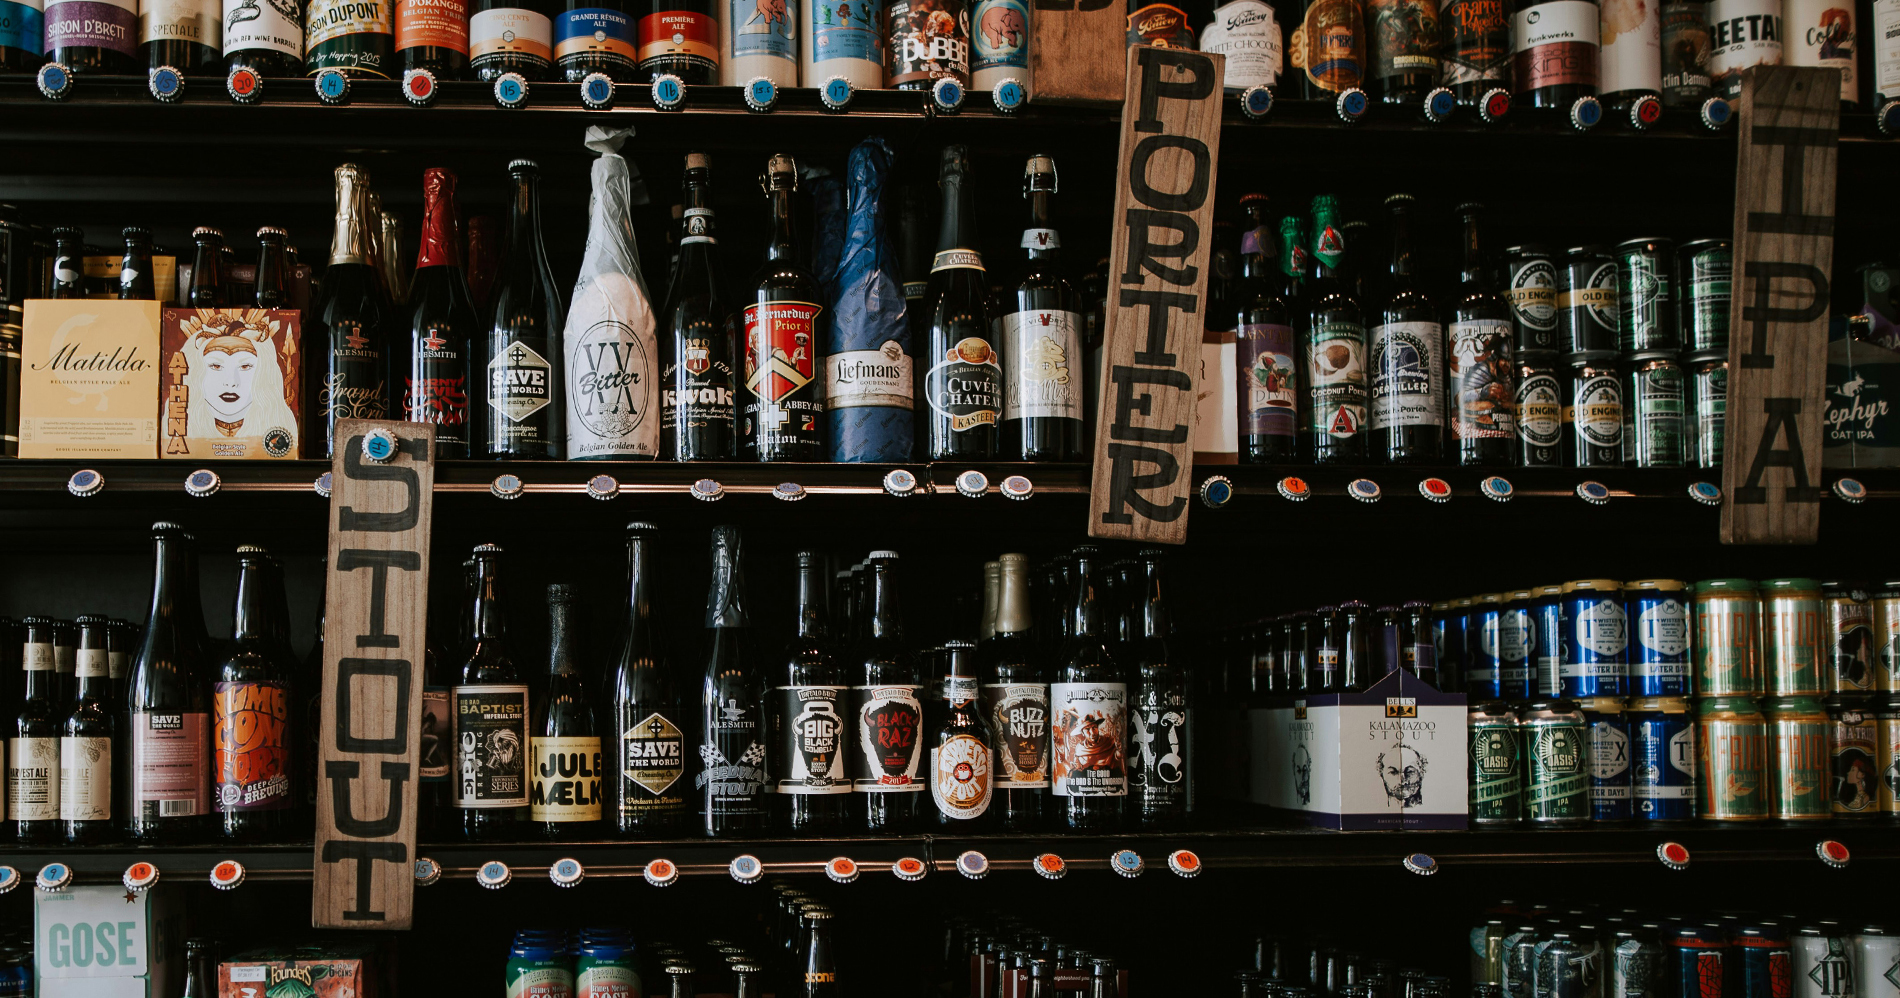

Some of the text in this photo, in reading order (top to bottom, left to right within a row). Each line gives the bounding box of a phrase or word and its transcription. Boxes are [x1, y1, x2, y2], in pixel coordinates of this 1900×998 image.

[328, 2, 380, 24] DUPONT
[403, 8, 440, 17] BELGIAN
[507, 14, 530, 22] CENTS
[570, 14, 599, 22] GRANDE
[662, 16, 696, 25] PREMIÈRE
[48, 20, 126, 40] SAISON D'BRETT
[152, 24, 200, 39] SPECIALE
[1527, 31, 1575, 44] funkwerks
[1730, 44, 1745, 52] CO.
[329, 51, 359, 67] Hopping
[504, 85, 516, 97] 15
[664, 82, 677, 97] 16
[833, 86, 846, 97] 17
[1003, 88, 1015, 102] 14
[1102, 47, 1216, 525] PORTER
[1582, 292, 1603, 302] OLD
[1733, 125, 1839, 505] IPA
[775, 319, 810, 331] Prior 8
[493, 370, 546, 391] SAVE
[835, 359, 901, 391] Liefmans
[579, 370, 642, 396] Bitter
[318, 373, 385, 411] Grand
[513, 387, 546, 396] WORLD
[1310, 386, 1345, 400] COCONUT
[166, 351, 189, 456] ATHENA
[784, 402, 810, 416] ABBEY
[1400, 404, 1428, 414] Porter
[958, 413, 996, 427] KASTEEL
[1831, 429, 1875, 441] OAT IPA
[579, 441, 649, 455] Belgian Golden Ale
[1587, 664, 1610, 674] LATER
[1650, 664, 1673, 674] LATER
[321, 432, 430, 921] STOUT
[460, 704, 523, 714] BAPTIST
[1009, 707, 1044, 723] BUZZ
[152, 715, 181, 724] SAVE
[877, 711, 914, 728] BLACK
[1369, 721, 1436, 731] KALAMAZOO
[804, 719, 834, 737] BIG
[1009, 721, 1045, 739] NUTZ
[804, 737, 834, 746] BLACK
[877, 727, 912, 749] RAZ
[1369, 731, 1436, 741] STOUT
[629, 740, 680, 758] SAVE
[1614, 740, 1627, 761] X
[540, 752, 602, 778] JULE
[629, 757, 680, 768] THE WORLD
[1483, 755, 1509, 768] OASIS
[1547, 755, 1574, 767] OASIS
[36, 767, 49, 778] ALE
[247, 781, 268, 793] DEEP
[491, 782, 519, 792] SERIES
[710, 780, 760, 796] STOUT
[811, 778, 827, 786] 2016
[939, 776, 984, 801] STOUT
[244, 783, 290, 805] BREWING
[1603, 787, 1624, 797] DAYS
[1492, 800, 1503, 808] IPA
[1557, 799, 1569, 807] IPA
[489, 865, 500, 874] 14
[48, 921, 137, 969] GOSE
[328, 964, 335, 978] 6
